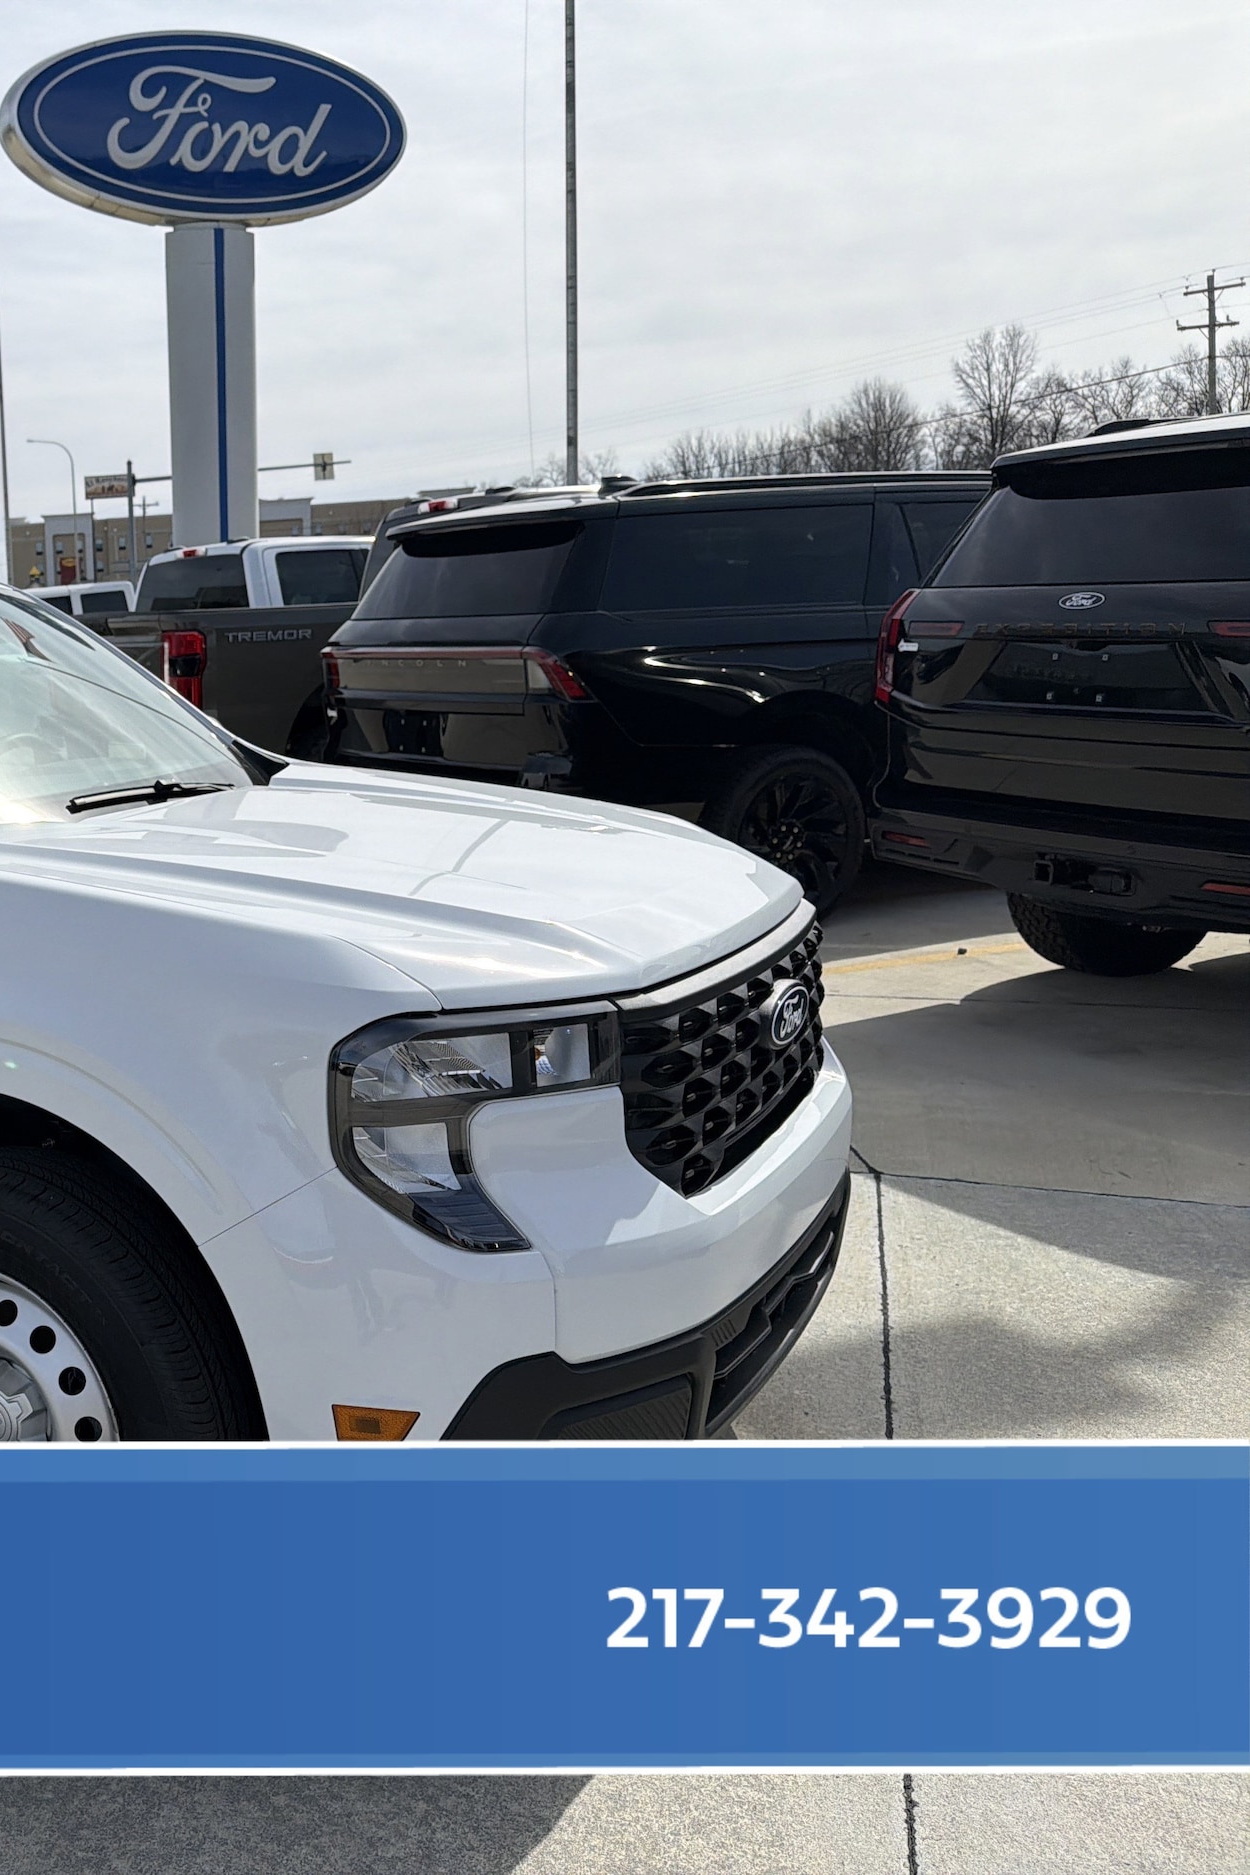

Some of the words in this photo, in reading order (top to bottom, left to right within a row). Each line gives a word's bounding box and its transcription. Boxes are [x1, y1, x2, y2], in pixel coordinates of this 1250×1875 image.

[106, 65, 332, 177] Ford
[225, 628, 312, 643] TREMOR
[780, 995, 804, 1039] Ford
